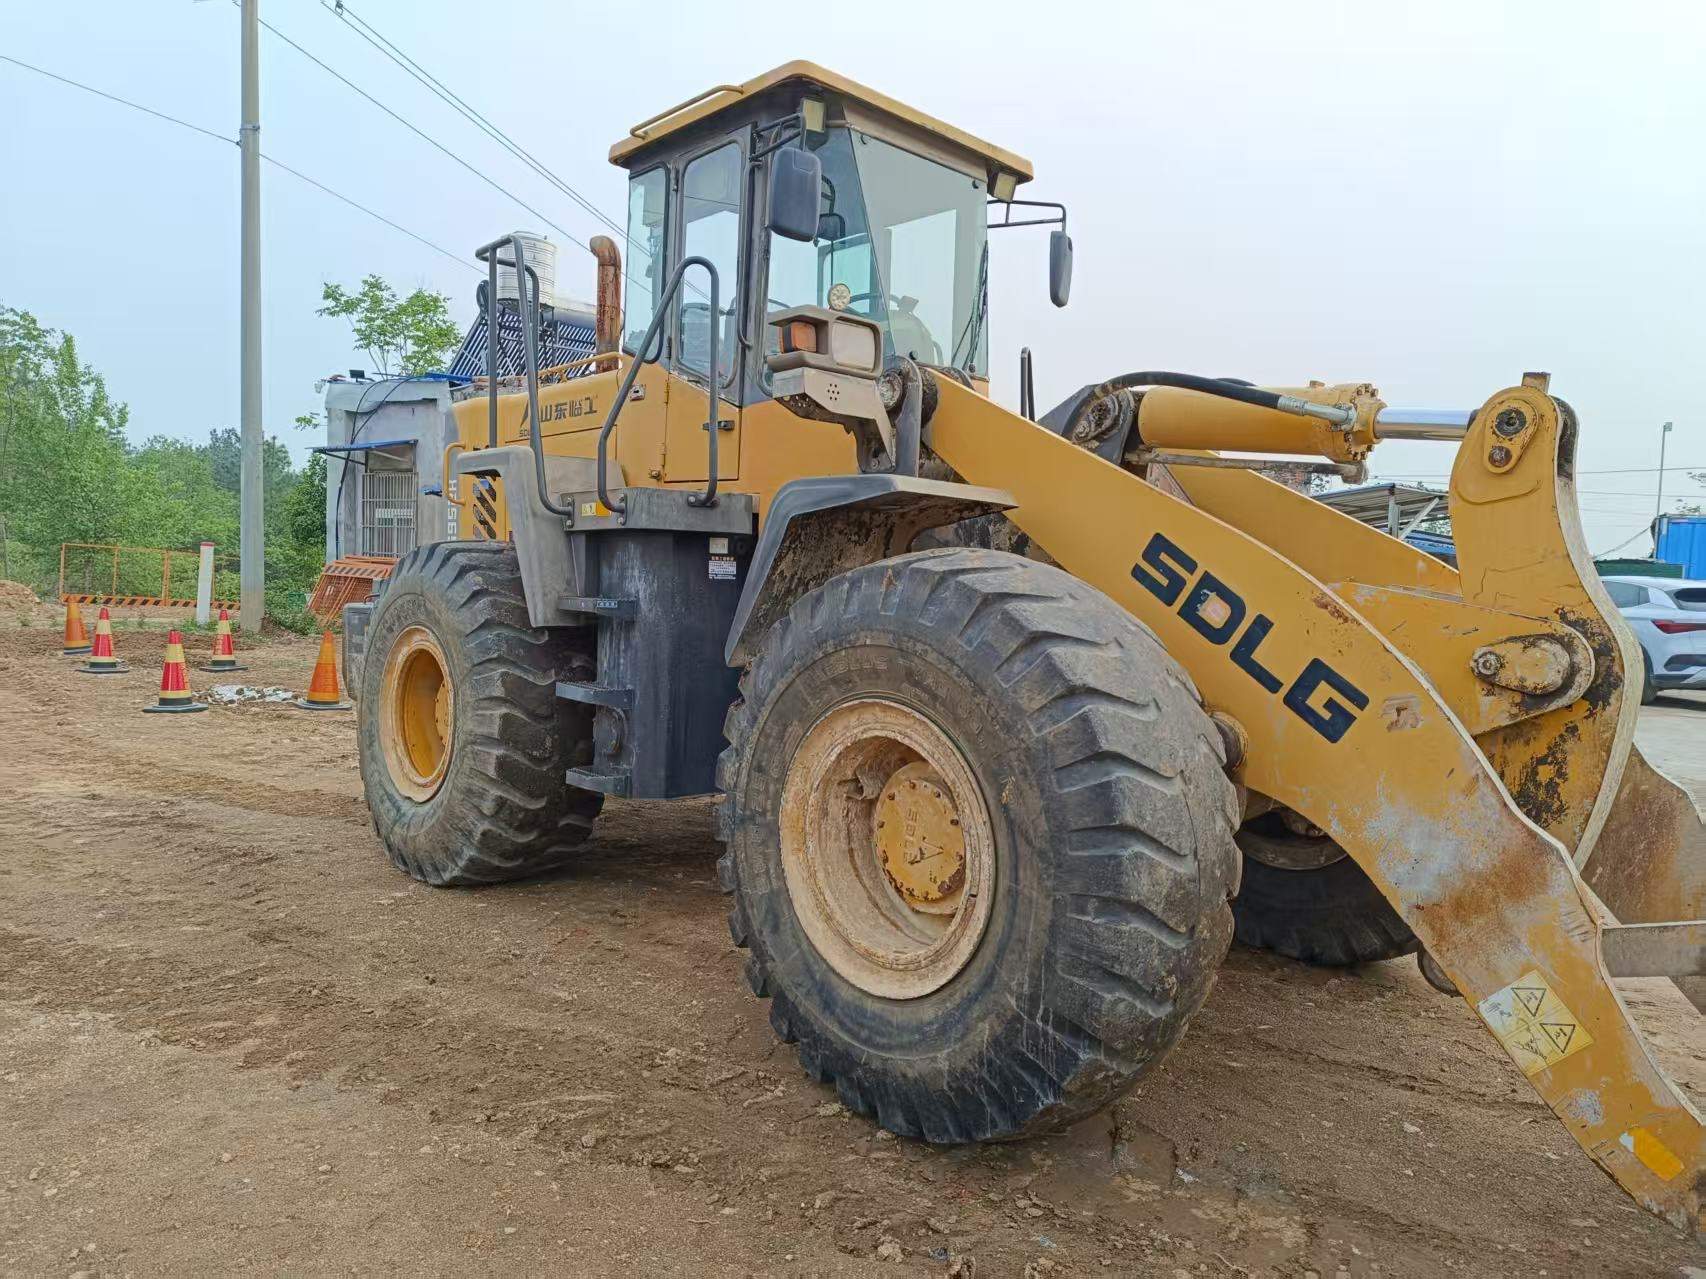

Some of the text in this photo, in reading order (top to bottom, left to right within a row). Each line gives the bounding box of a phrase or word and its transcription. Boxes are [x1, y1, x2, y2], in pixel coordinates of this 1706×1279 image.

[540, 397, 598, 423] 山东临工
[1131, 532, 1370, 744] SDLG
